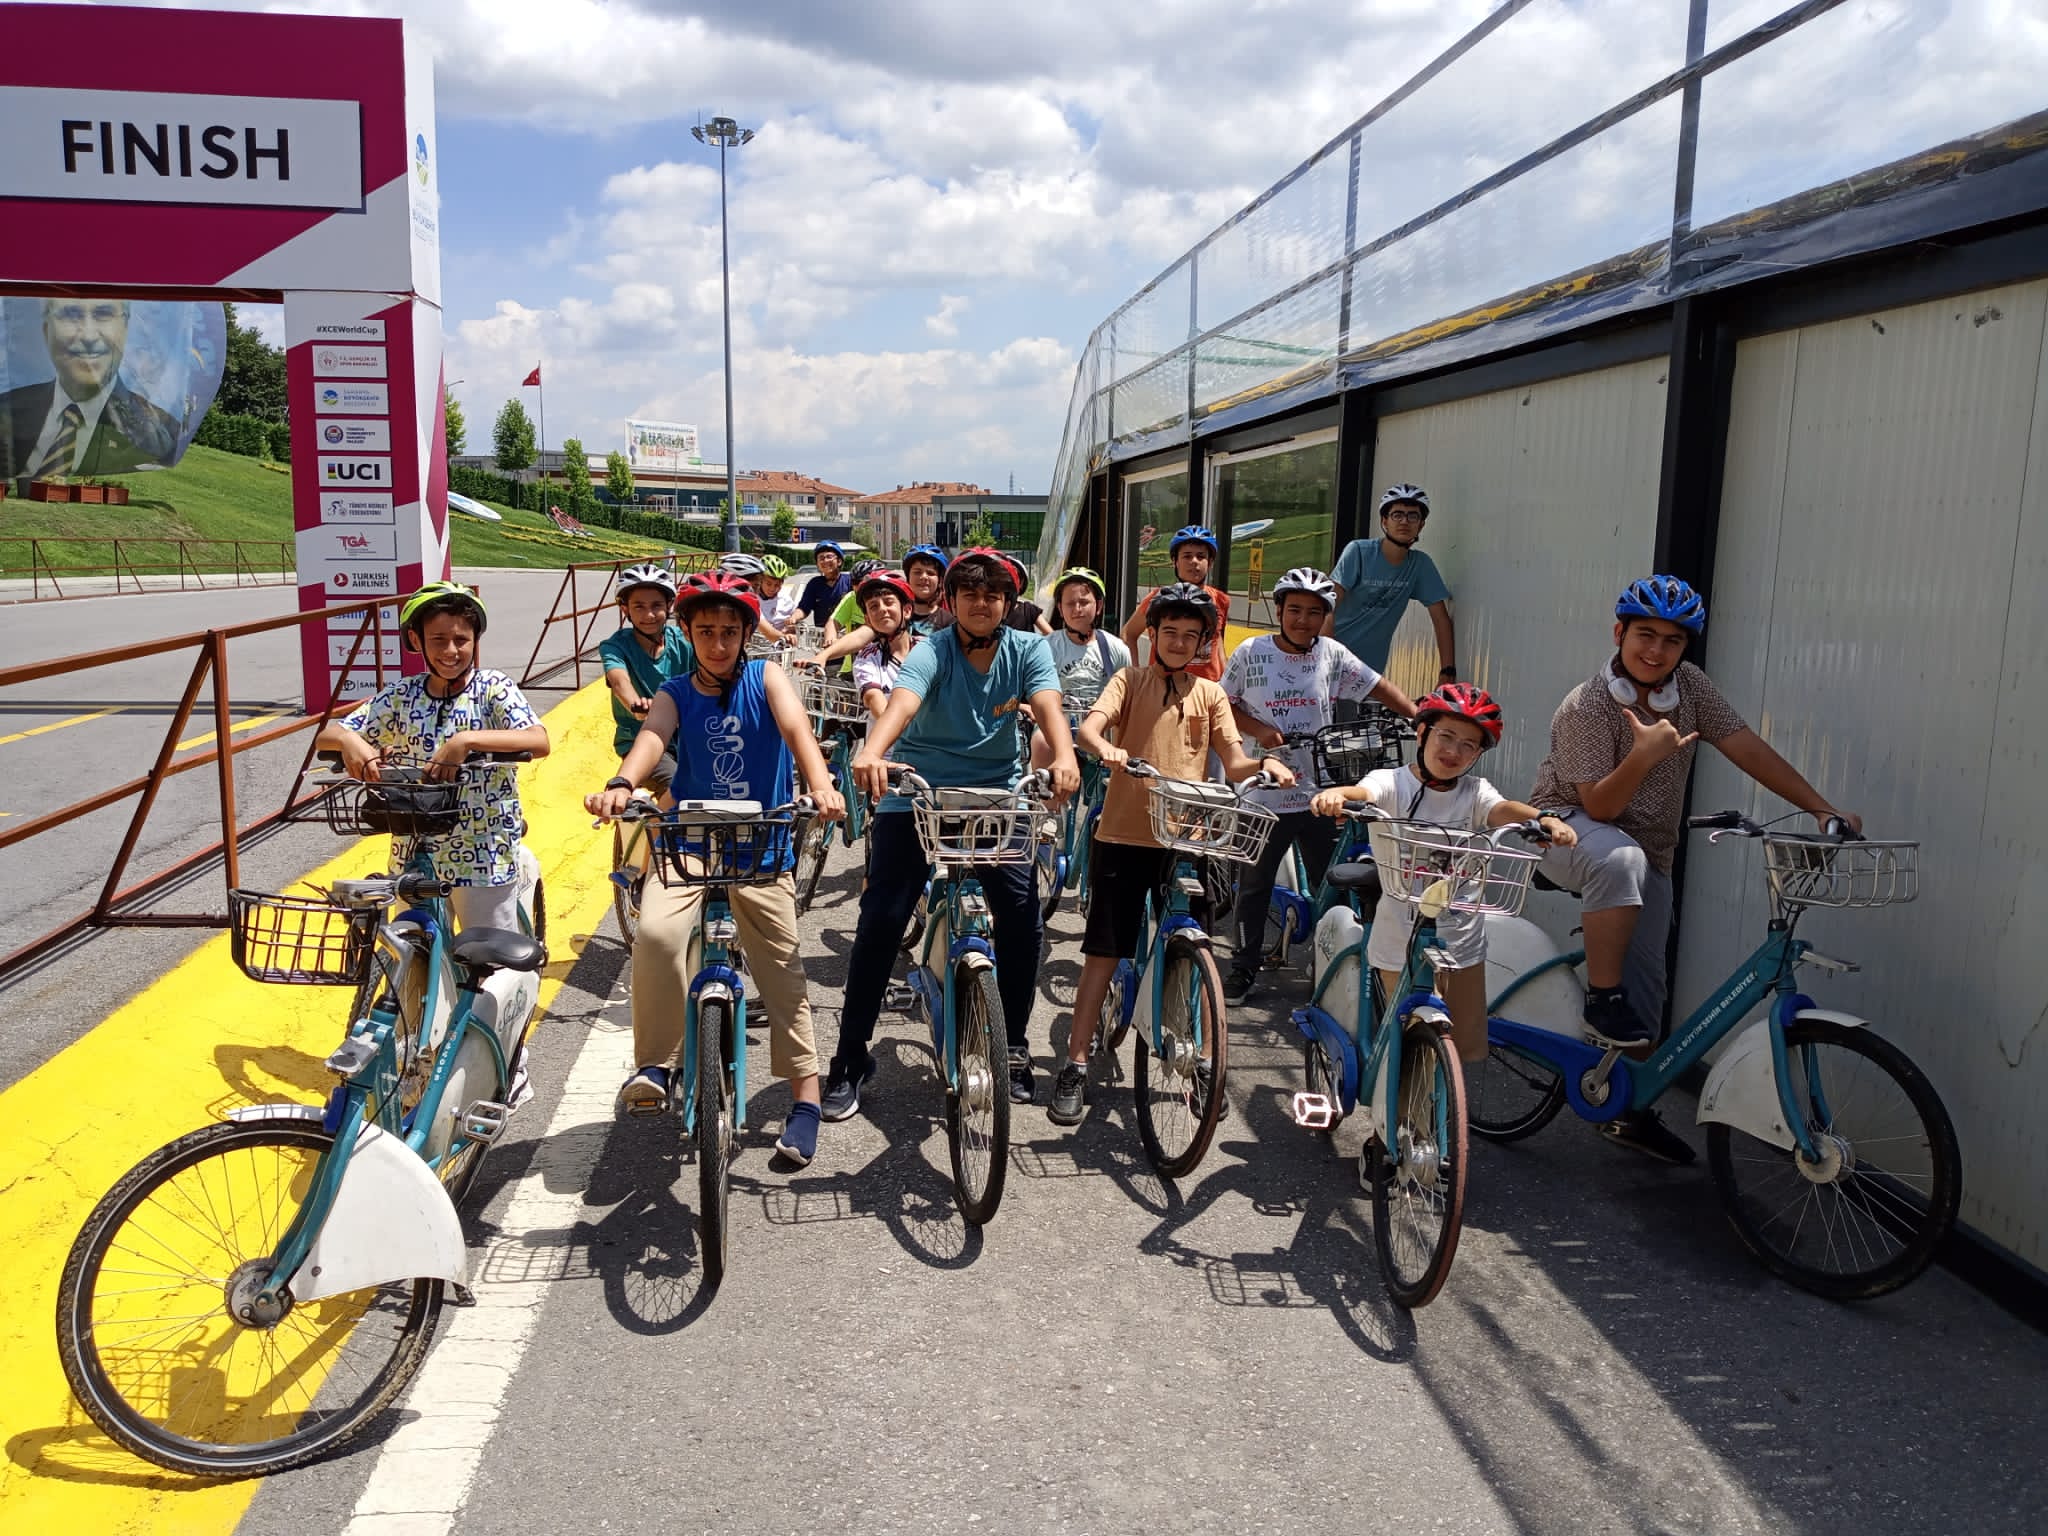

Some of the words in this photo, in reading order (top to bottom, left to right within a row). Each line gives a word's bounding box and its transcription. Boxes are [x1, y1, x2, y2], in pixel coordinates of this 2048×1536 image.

[62, 119, 290, 181] FINISH
[316, 325, 378, 335] #XCEWorldCup
[337, 463, 381, 480] UCI
[335, 533, 371, 551] TGA
[352, 572, 389, 580] TURKISH
[352, 580, 390, 588] AIRLINES
[1248, 654, 1275, 665] LOVE
[1274, 689, 1305, 700] HAPPY
[1271, 707, 1290, 717] DAY
